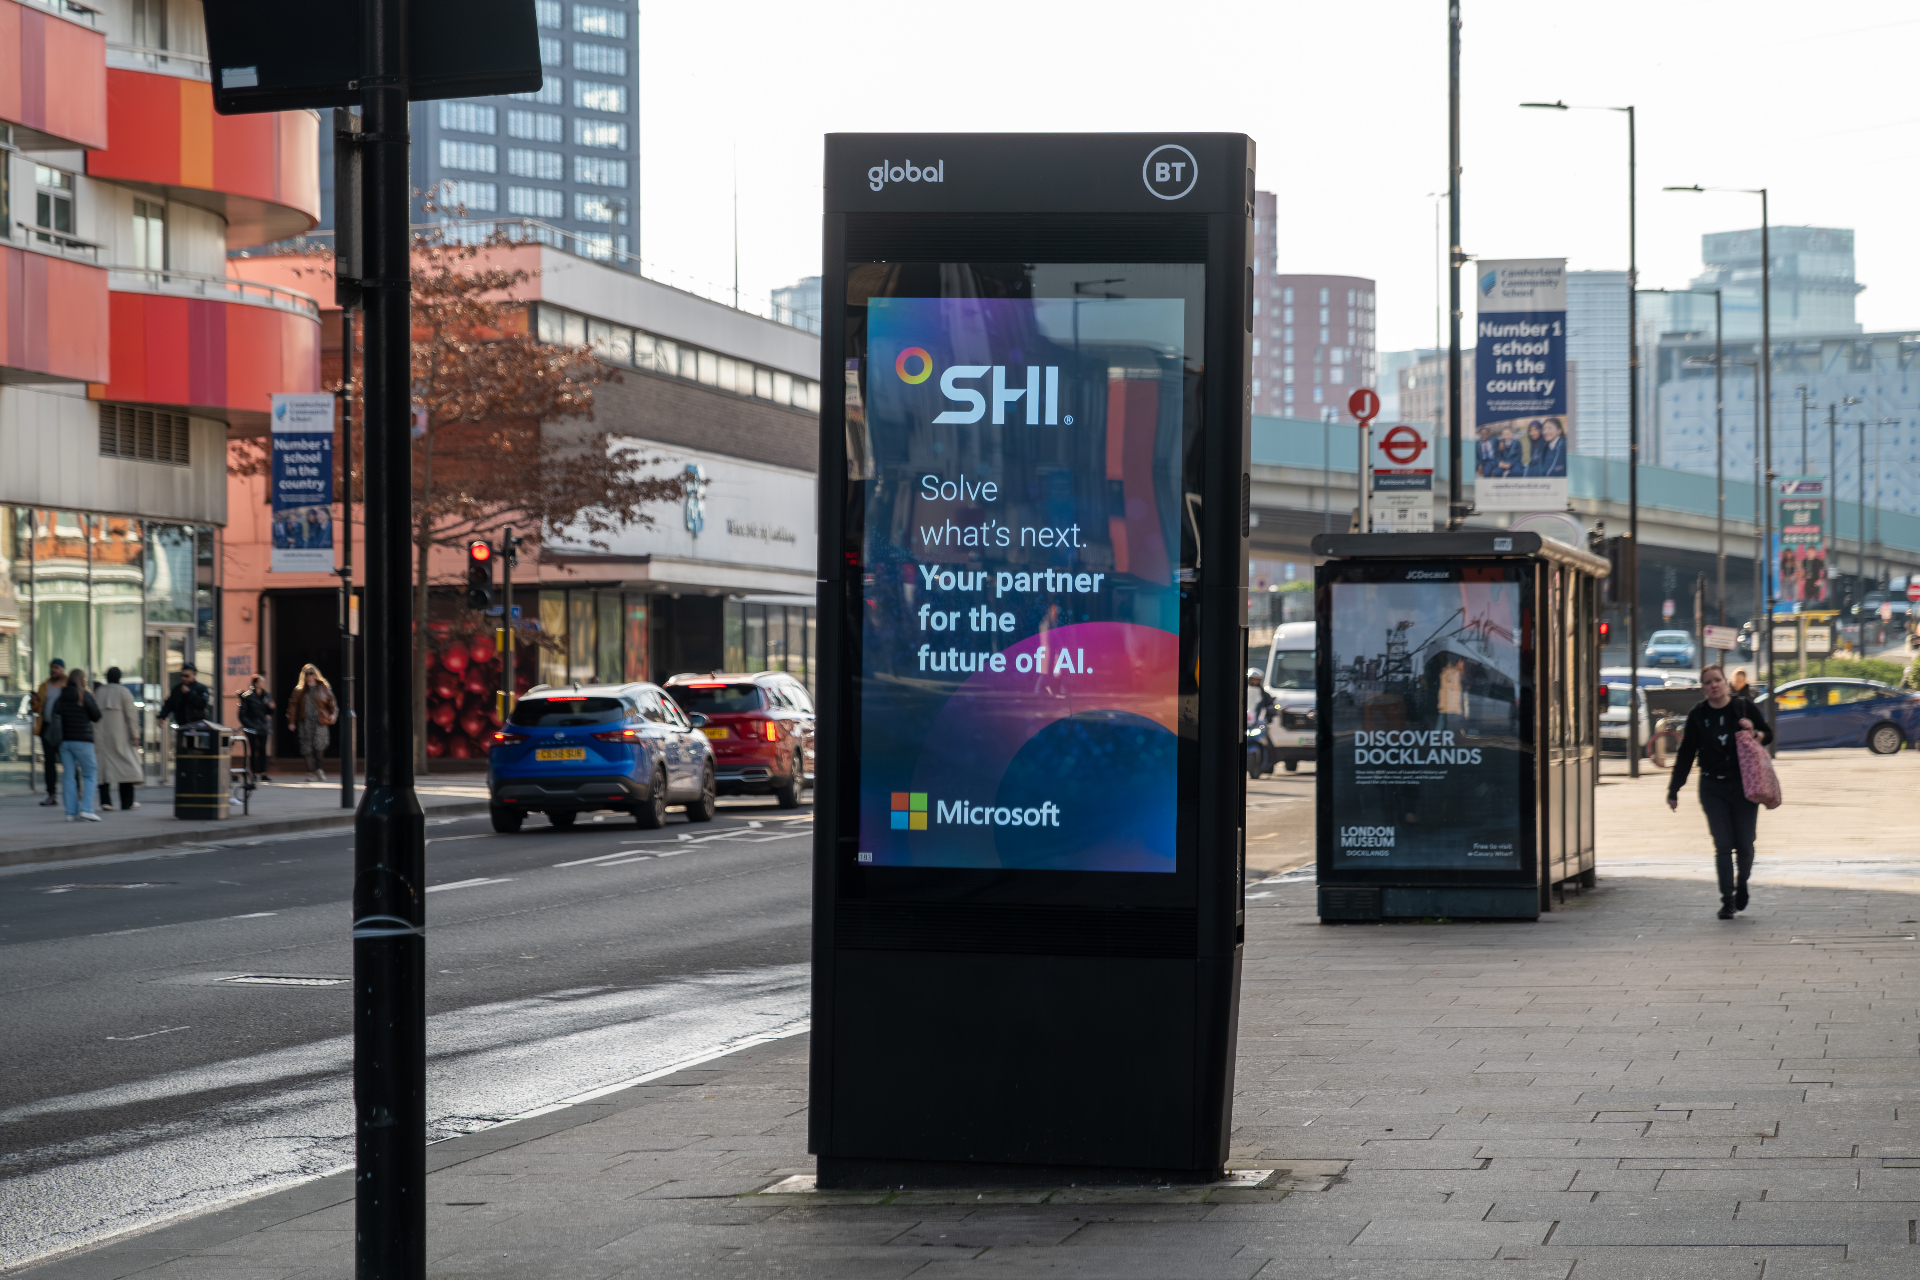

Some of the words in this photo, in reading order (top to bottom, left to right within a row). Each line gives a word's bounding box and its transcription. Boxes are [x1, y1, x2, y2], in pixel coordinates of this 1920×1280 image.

[868, 159, 943, 191] global
[1155, 162, 1186, 182] BT
[1479, 321, 1549, 337] Number
[1552, 320, 1562, 336] 1
[1492, 339, 1550, 356] school
[1496, 357, 1513, 374] in
[1515, 357, 1546, 374] the
[1486, 377, 1555, 396] country
[1355, 393, 1371, 418] J
[273, 438, 322, 451] Number
[322, 438, 331, 451] 1
[283, 451, 322, 464] school
[285, 464, 297, 476] in
[298, 464, 320, 476] the
[278, 478, 326, 492] country
[921, 474, 998, 501] Solve
[921, 519, 1010, 547] what's
[1021, 522, 1087, 548] next.
[919, 564, 987, 592] Your
[996, 568, 1105, 598] partner
[1406, 570, 1450, 579] JCDecaux
[918, 604, 961, 632] for
[968, 604, 1016, 633] the
[918, 644, 1007, 673] future
[1015, 644, 1046, 674] of
[1053, 648, 1094, 675] AI.
[1354, 730, 1455, 747] DISCOVER
[1354, 748, 1482, 765] DOCKLANDS
[937, 800, 1060, 826] Microsoft
[1340, 826, 1395, 837] LONDON
[1340, 837, 1395, 848] MUSEUM
